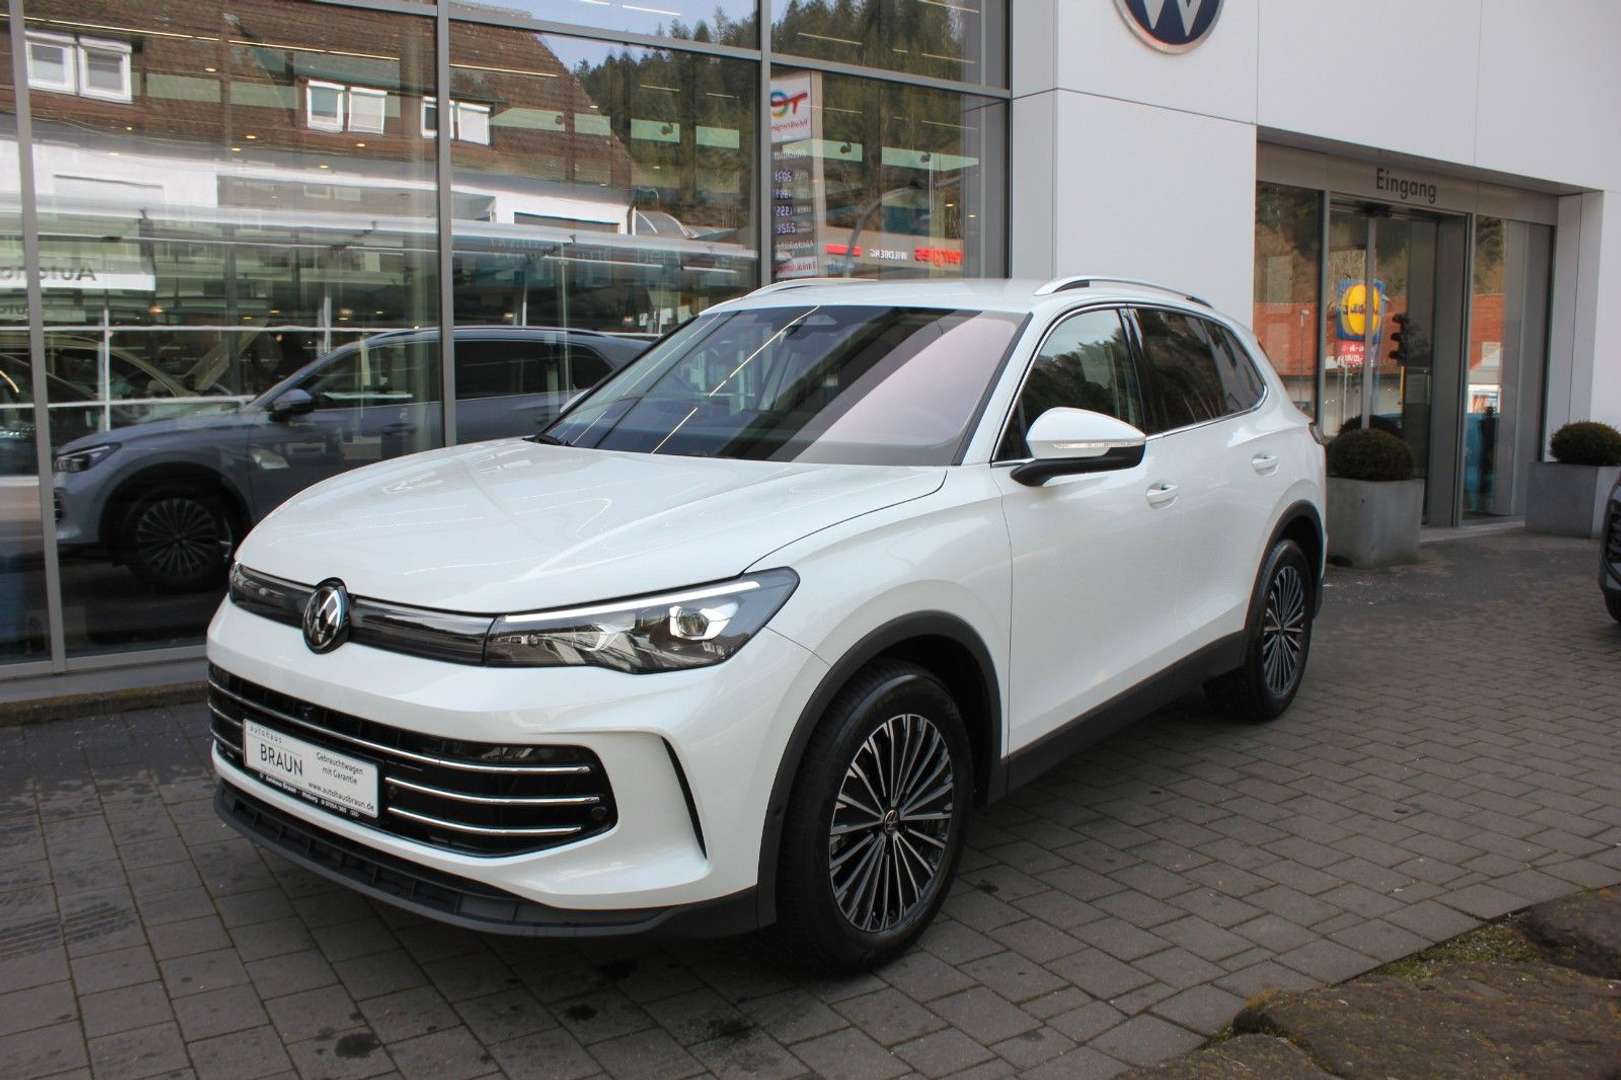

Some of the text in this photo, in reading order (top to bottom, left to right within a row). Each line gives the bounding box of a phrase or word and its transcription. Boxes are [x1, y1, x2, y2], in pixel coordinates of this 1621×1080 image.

[1375, 168, 1437, 203] Eingang
[260, 743, 303, 776] BRAUN
[316, 751, 364, 775] Gebrauchtwagen
[322, 767, 357, 784] mit Garantie
[308, 782, 374, 811] www.autohausbraun.de
